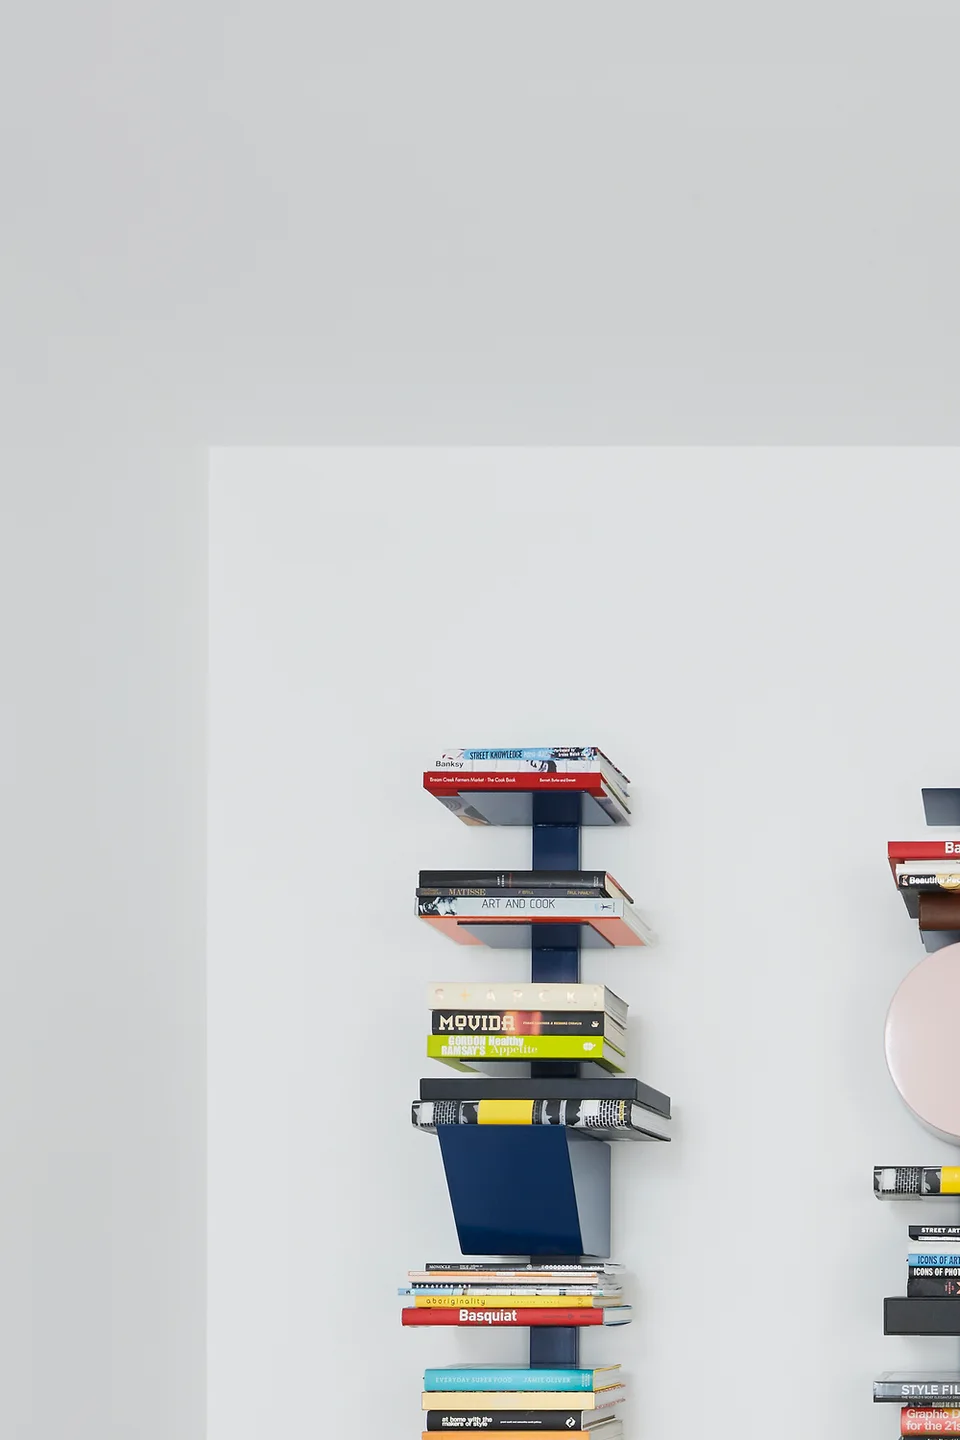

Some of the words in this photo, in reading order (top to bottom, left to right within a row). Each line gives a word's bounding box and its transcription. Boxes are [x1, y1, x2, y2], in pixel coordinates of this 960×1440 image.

[470, 751, 488, 760] STREET
[490, 750, 522, 760] KNOWLEDGE
[482, 899, 501, 908] ART
[505, 899, 525, 908] AND
[530, 899, 555, 908] COOK
[439, 1015, 515, 1030] MOVIDA
[448, 1036, 486, 1045] GORDON
[488, 1036, 524, 1046] Healthy
[441, 1046, 486, 1055] RAMSAY'S
[491, 1045, 538, 1055] Appetite
[918, 1256, 937, 1264] ICONS
[939, 1256, 946, 1264] OF
[426, 1298, 486, 1306] aboriginality
[459, 1309, 517, 1324] Basquiat
[902, 1385, 938, 1395] STYLE
[907, 1409, 948, 1420] Graphic
[906, 1421, 922, 1430] for
[924, 1421, 942, 1430] the
